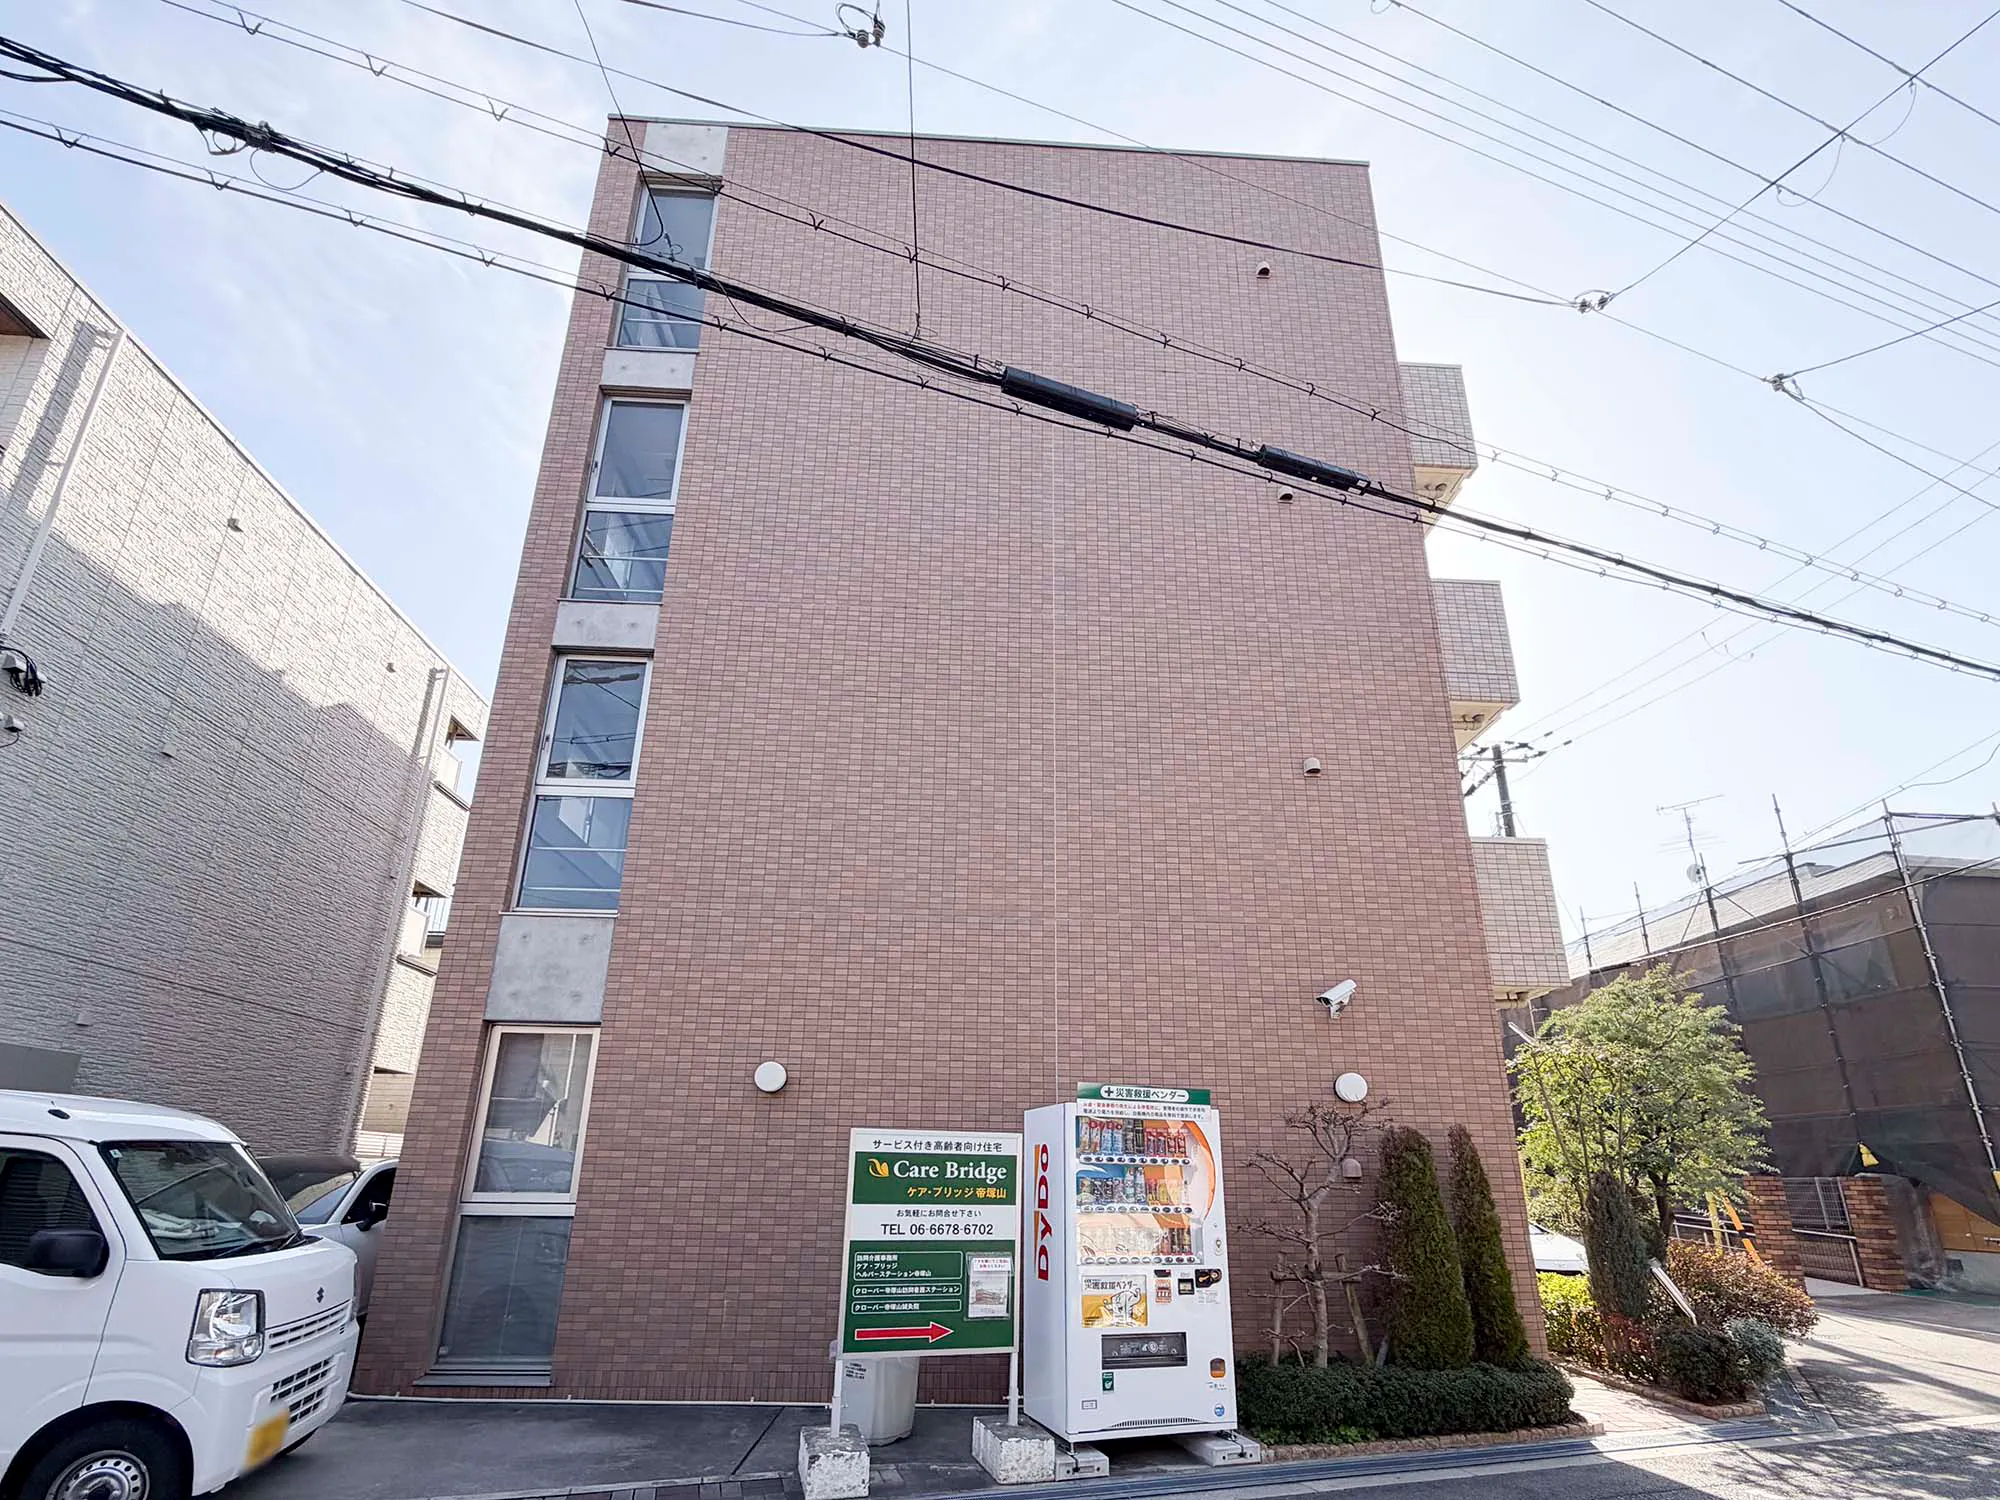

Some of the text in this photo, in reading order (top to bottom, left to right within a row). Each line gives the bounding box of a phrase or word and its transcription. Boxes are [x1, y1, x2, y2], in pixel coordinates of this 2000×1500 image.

[1115, 1087, 1187, 1100] 災害救援ベンダー
[873, 1139, 1003, 1153] サービス付き高齢者向け住宅
[893, 1157, 1008, 1184] Care Bridge
[896, 1209, 982, 1218] お気軽にお問合せ下さい
[881, 1224, 994, 1236] TEL 06-6678-6702
